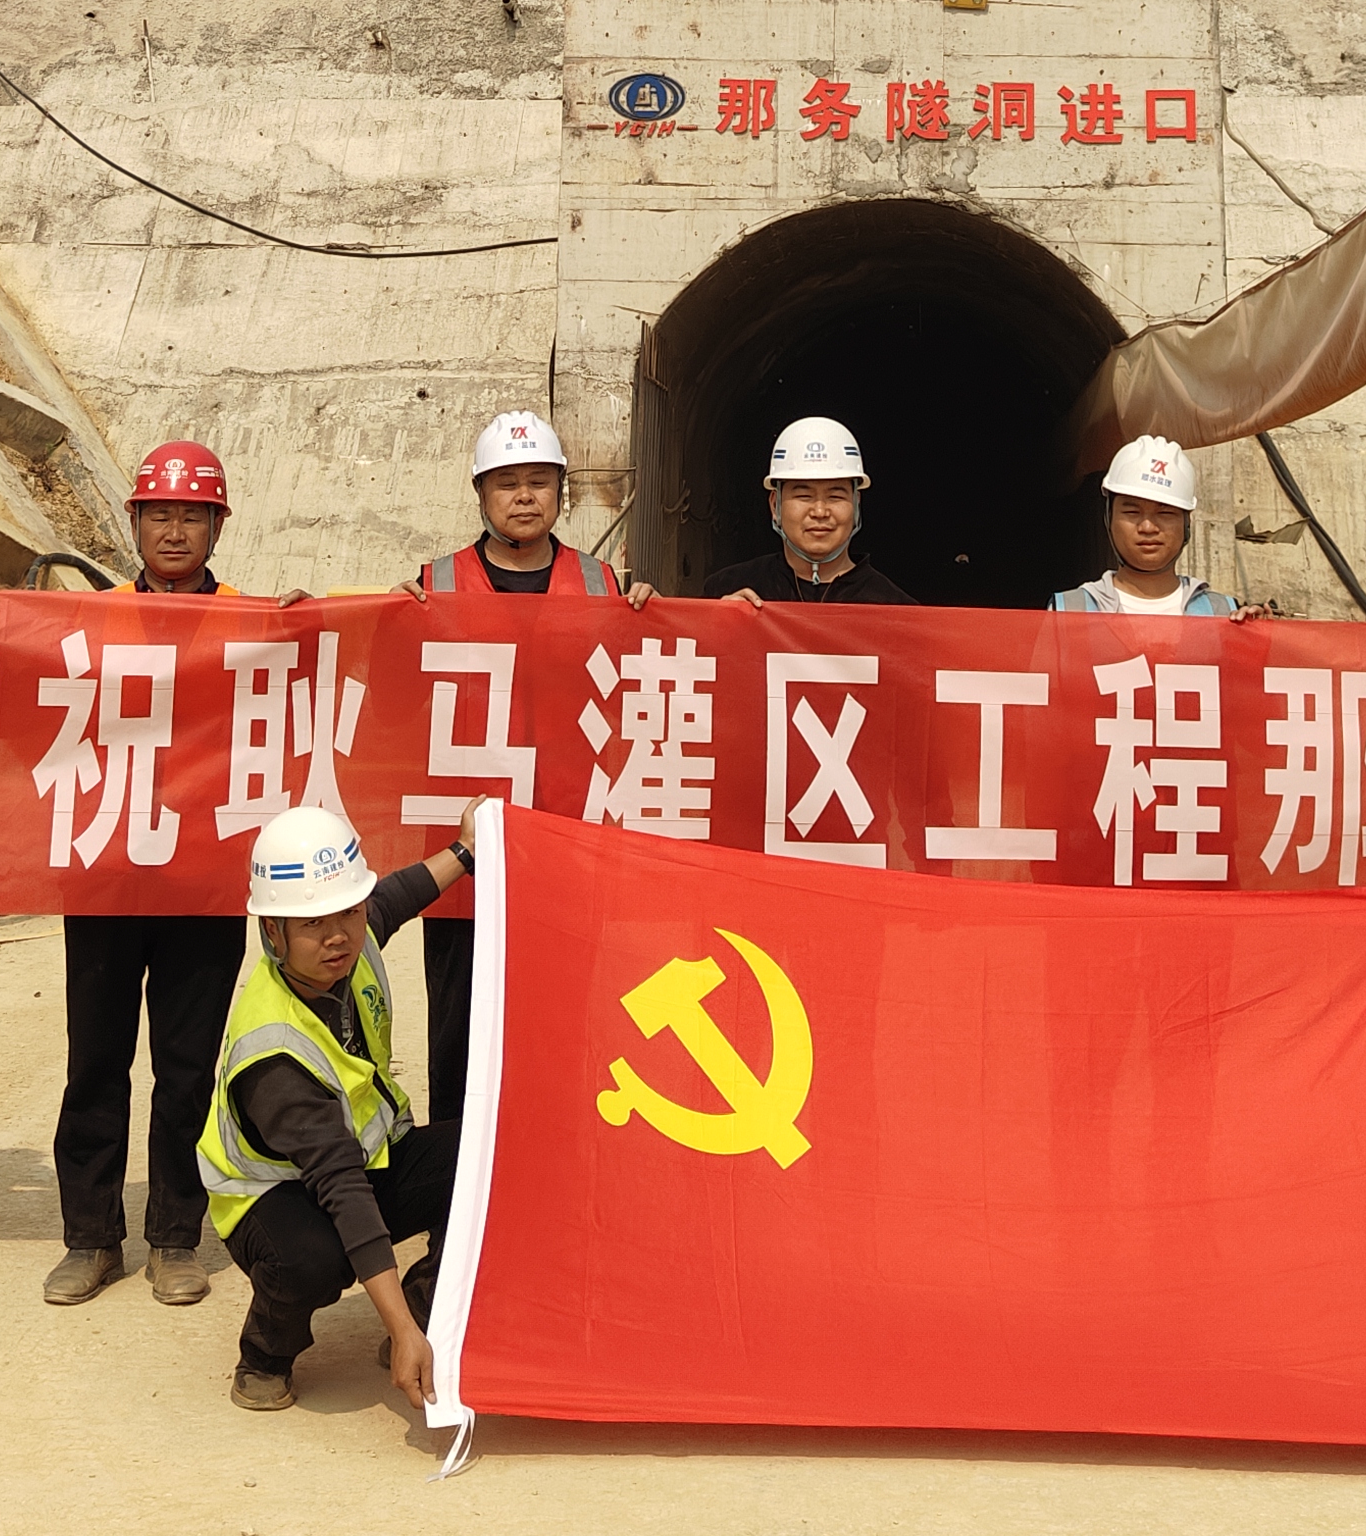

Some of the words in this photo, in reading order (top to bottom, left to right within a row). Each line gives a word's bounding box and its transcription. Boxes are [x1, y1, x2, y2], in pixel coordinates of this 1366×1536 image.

[614, 119, 676, 138] YCIH
[716, 78, 1198, 145] 那务隧洞进口
